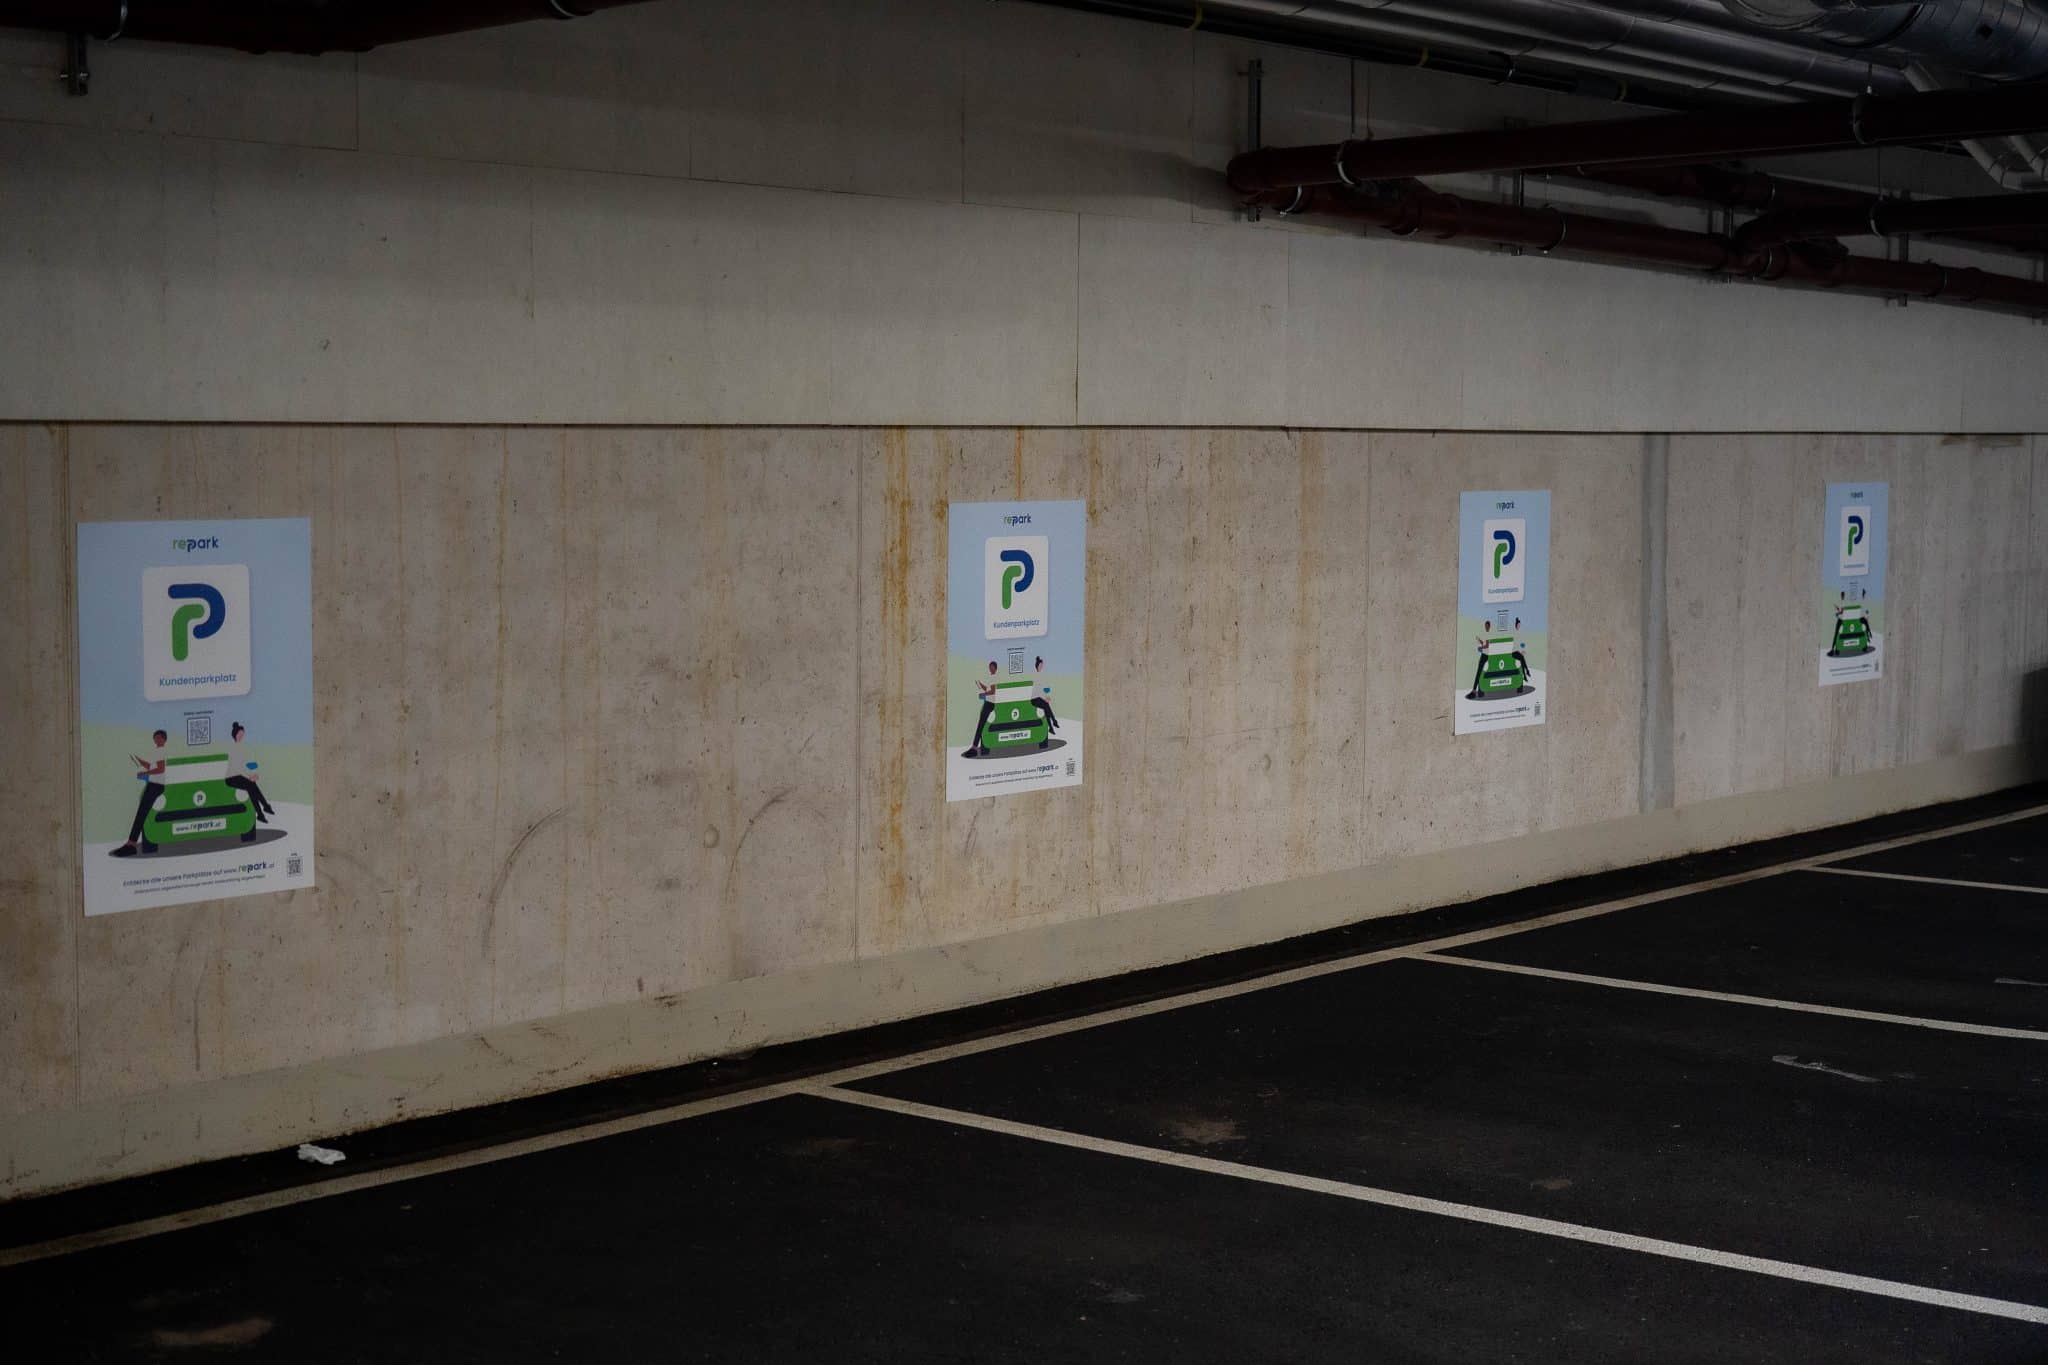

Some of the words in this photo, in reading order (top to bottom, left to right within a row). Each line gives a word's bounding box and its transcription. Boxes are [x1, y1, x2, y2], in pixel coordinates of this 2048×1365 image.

[1002, 513, 1032, 526] repark
[172, 536, 219, 552] repark
[159, 673, 237, 686] Kundenparkplatz
